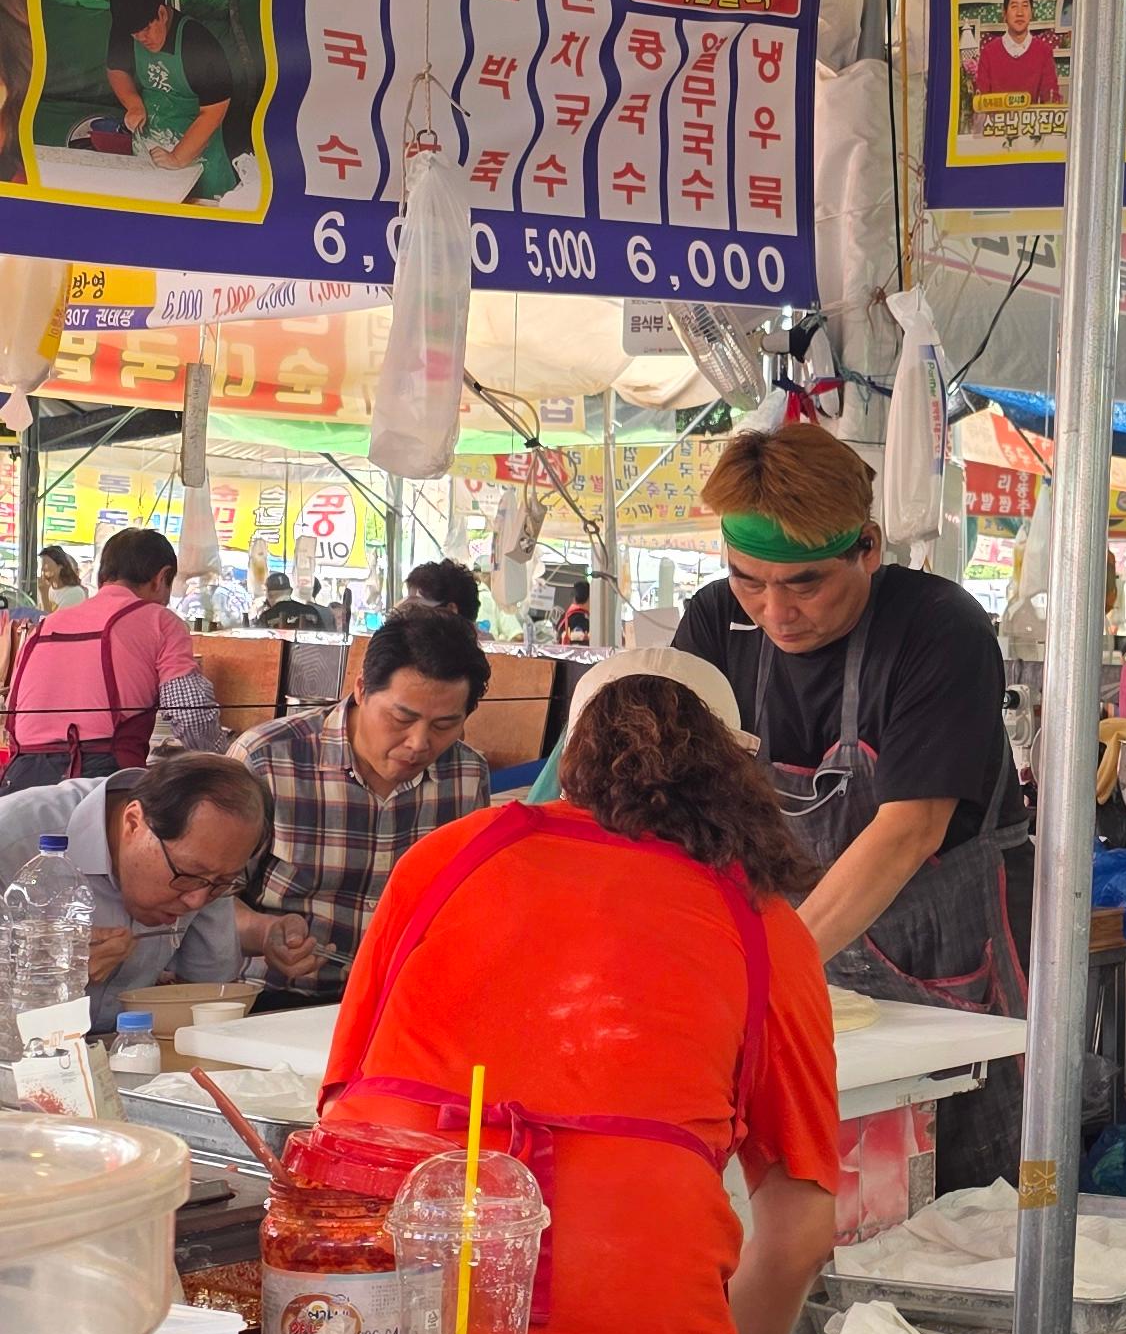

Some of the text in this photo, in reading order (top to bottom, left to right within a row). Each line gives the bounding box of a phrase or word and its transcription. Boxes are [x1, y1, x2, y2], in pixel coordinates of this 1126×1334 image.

[983, 111, 1019, 137] 소문난
[525, 227, 595, 283] 5,000
[627, 235, 785, 294] 6,000
[72, 271, 105, 299] 방영
